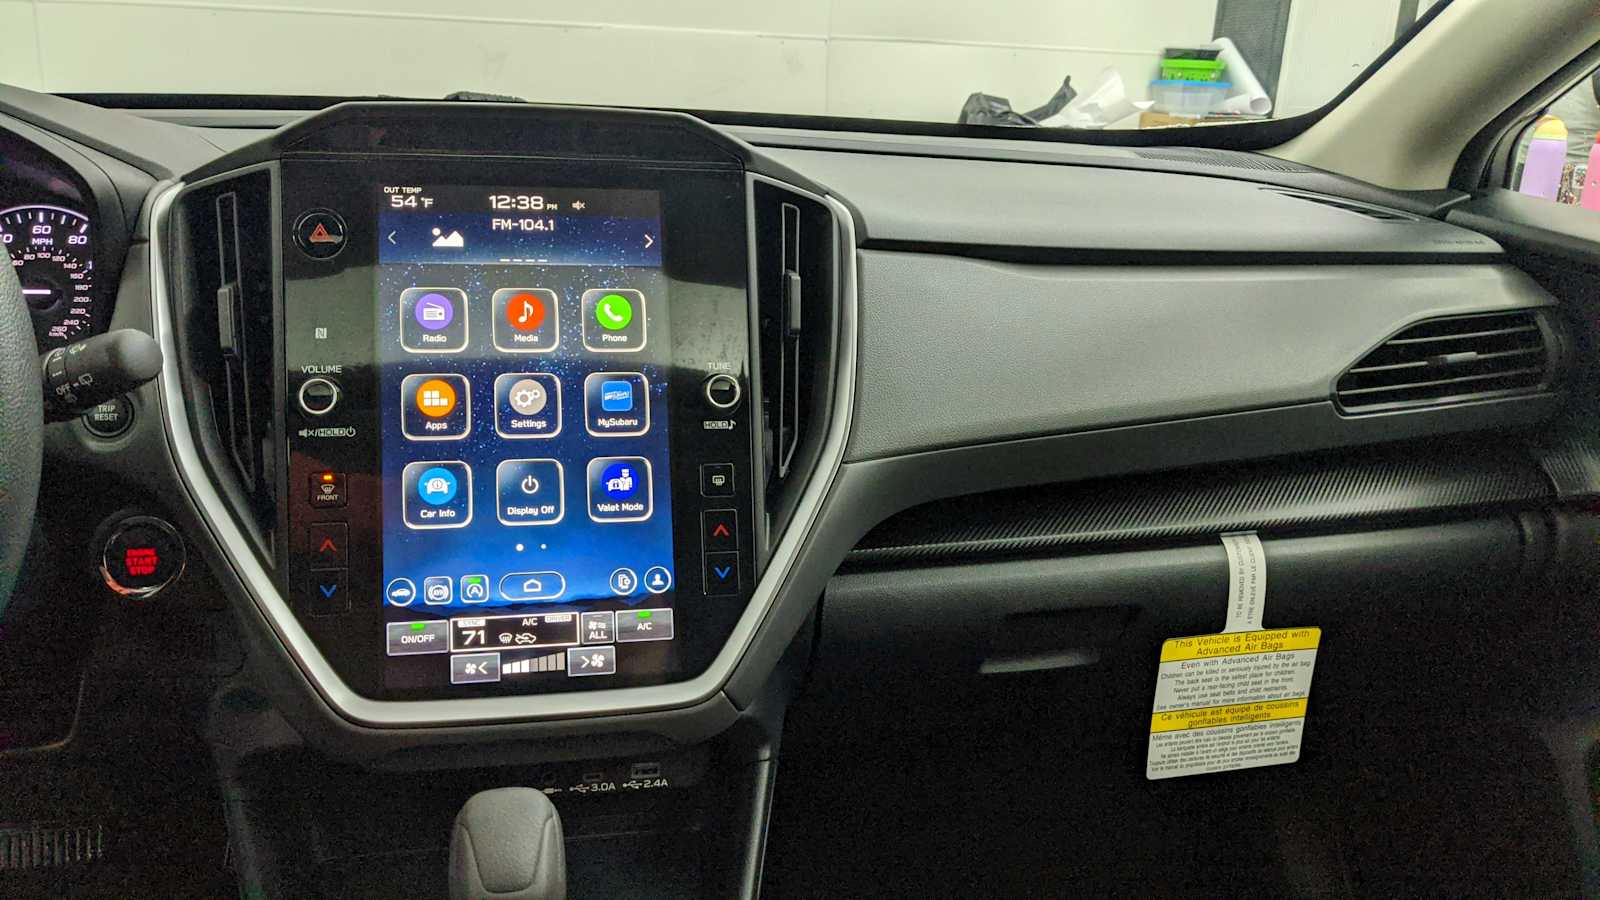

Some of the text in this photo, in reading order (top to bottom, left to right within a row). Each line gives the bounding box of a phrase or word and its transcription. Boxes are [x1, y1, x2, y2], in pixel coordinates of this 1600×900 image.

[391, 195, 417, 208] 54
[489, 195, 544, 209] 12:38
[492, 219, 554, 231] FM-104.1
[32, 226, 52, 234] 60
[68, 236, 87, 244] 80
[423, 334, 446, 342] Radio
[514, 334, 538, 342] Media
[602, 334, 627, 342] Phone
[301, 365, 342, 373] VOLUME
[707, 362, 731, 370] TUNE
[56, 383, 71, 395] OFF
[94, 413, 119, 421] RESET
[425, 421, 447, 430] Apps
[511, 420, 547, 429] Settings
[598, 418, 638, 427] MySubaru
[507, 505, 555, 516] Display Off
[597, 503, 644, 512] Valet Mode
[420, 509, 455, 518] Car Info
[522, 618, 538, 626] A/C
[637, 622, 652, 630] A/C
[401, 634, 435, 644] ON/OFF
[462, 630, 485, 645] 71
[589, 631, 607, 640] ALL
[1174, 629, 1310, 648] This Vehicle is Equipped with
[1196, 640, 1284, 655] Advanced Air Bags
[1180, 661, 1200, 669] Even
[1221, 655, 1259, 665] Advanced
[1275, 652, 1295, 661] Bags
[1160, 713, 1172, 721] Ce
[1187, 711, 1271, 727] gonflables intelligents
[591, 783, 616, 791] 3.0A
[643, 779, 668, 788] 2.4A
